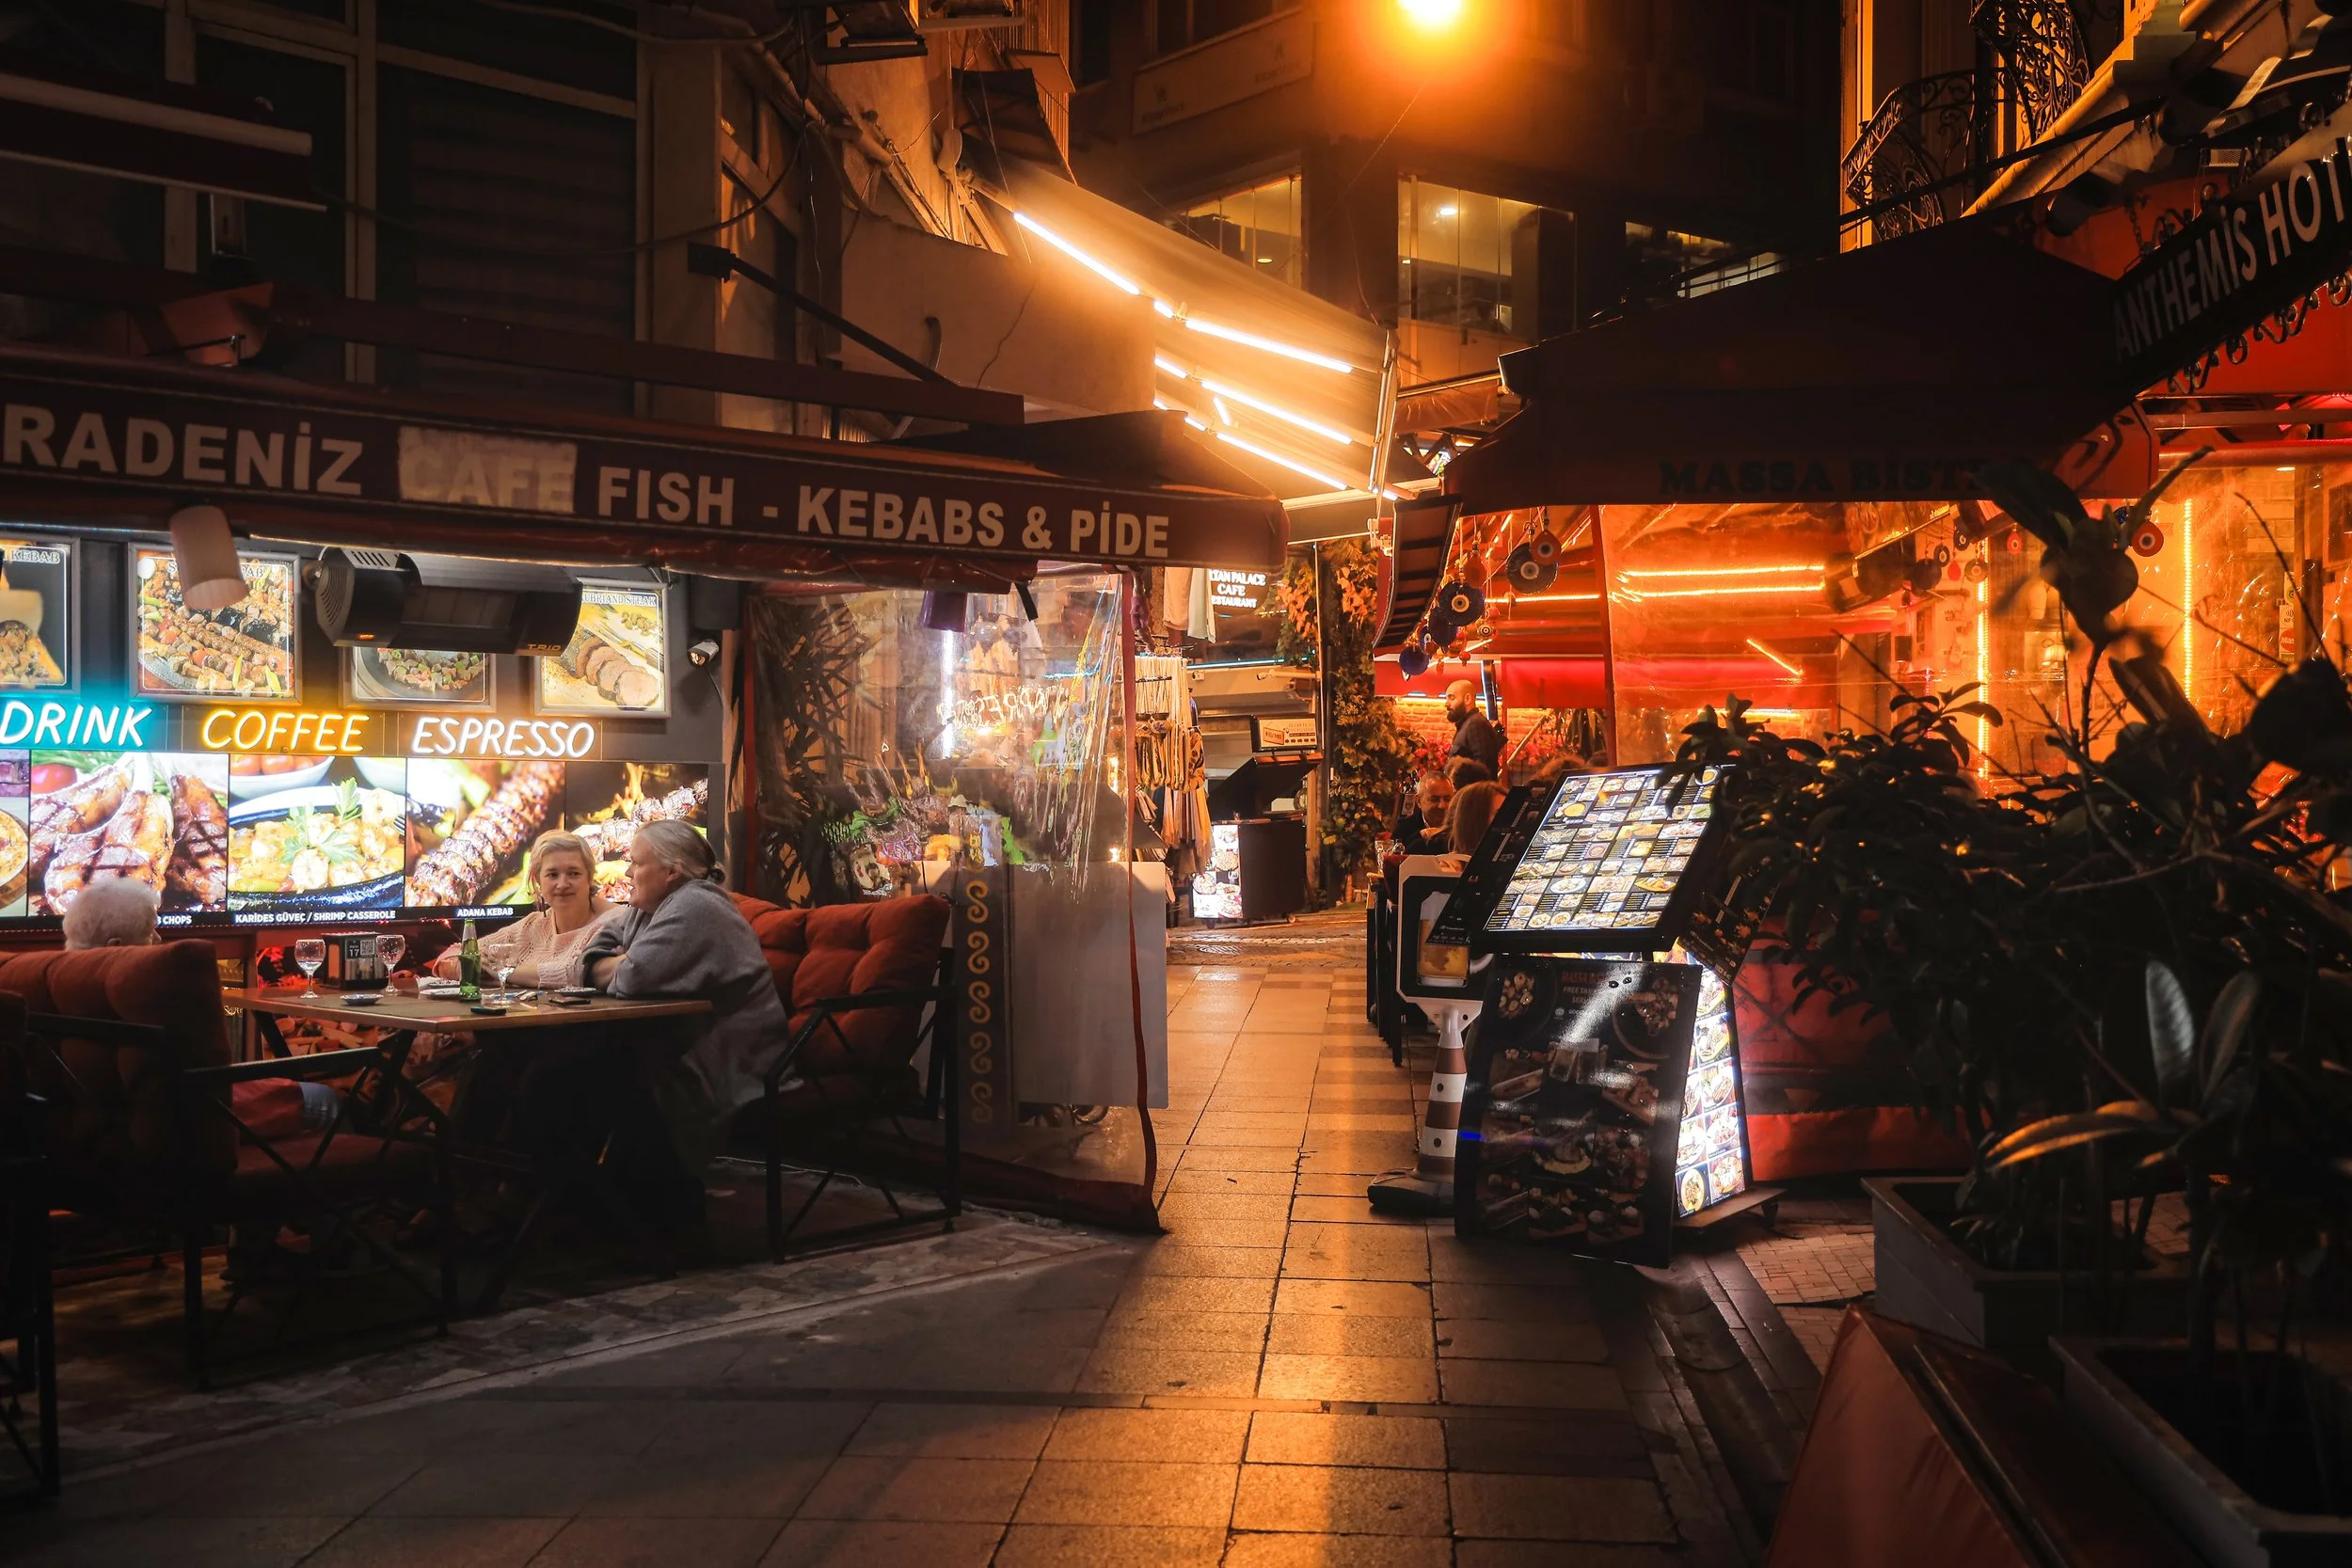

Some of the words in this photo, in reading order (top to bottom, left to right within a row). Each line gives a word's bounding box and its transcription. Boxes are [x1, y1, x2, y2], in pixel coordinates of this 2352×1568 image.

[2259, 135, 2352, 266] HOT
[4, 404, 363, 496] RADENİZ
[403, 445, 576, 514] CAFE
[598, 466, 735, 527] FISH
[797, 484, 1005, 547] KEBABS
[1022, 505, 1053, 550] &
[1070, 500, 1169, 558] PİDE
[1659, 459, 1835, 494] MASSA
[1849, 455, 1991, 492] BİST
[11, 549, 60, 564] KEBAB
[1232, 571, 1266, 586] PALACE
[1216, 583, 1247, 596] CAFE
[582, 593, 624, 605] UBRIAND
[626, 594, 657, 607] STEAK
[1211, 594, 1257, 609] ESTAURANT
[0, 701, 151, 748] DRINK
[200, 708, 370, 752] COFFEE
[411, 717, 596, 758] ESPRESSO
[235, 911, 275, 924] KARİDES
[313, 911, 346, 922] SHRIMP
[347, 910, 396, 921] CASSEROLE
[457, 908, 485, 918] ADANA
[486, 907, 514, 916] KEBAB
[163, 915, 193, 926] CHOPS
